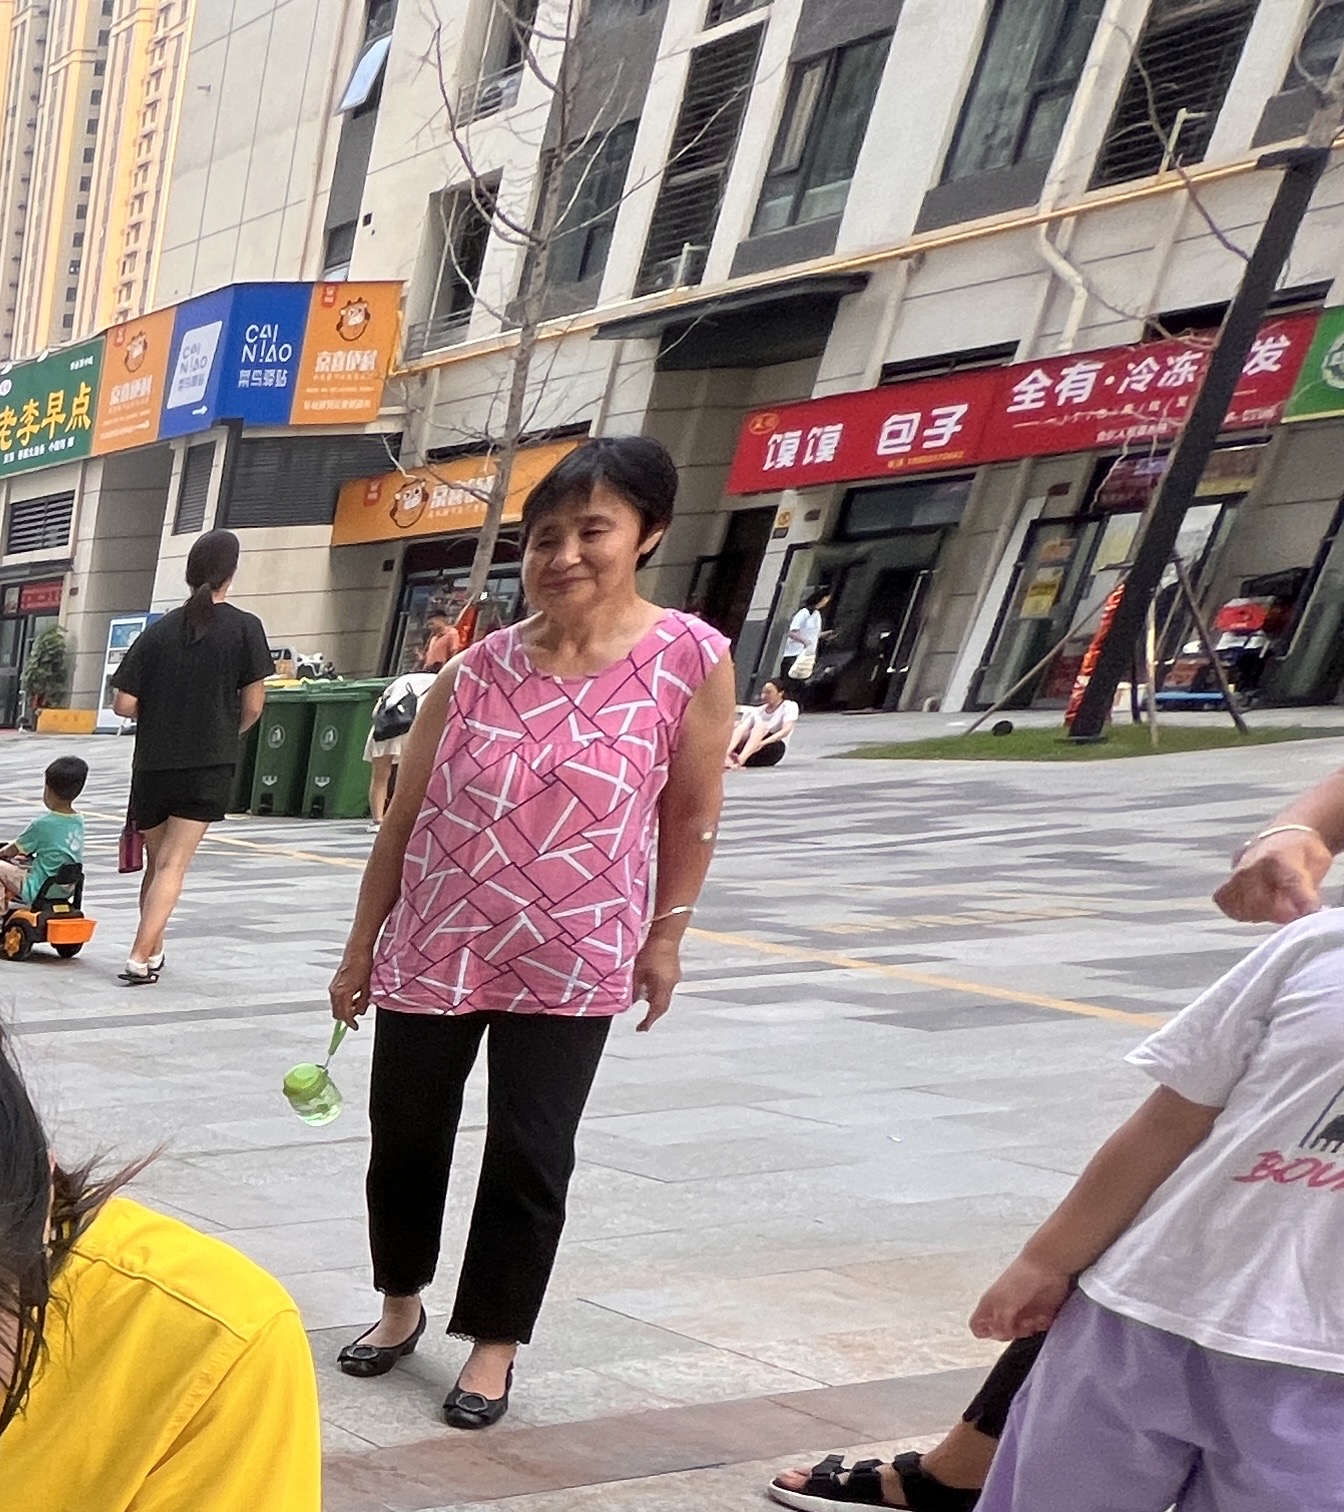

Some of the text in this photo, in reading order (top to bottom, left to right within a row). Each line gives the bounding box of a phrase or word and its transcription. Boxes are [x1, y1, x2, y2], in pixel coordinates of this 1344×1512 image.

[1006, 333, 1292, 413] 全有·冷冻发
[877, 402, 969, 457] 包子
